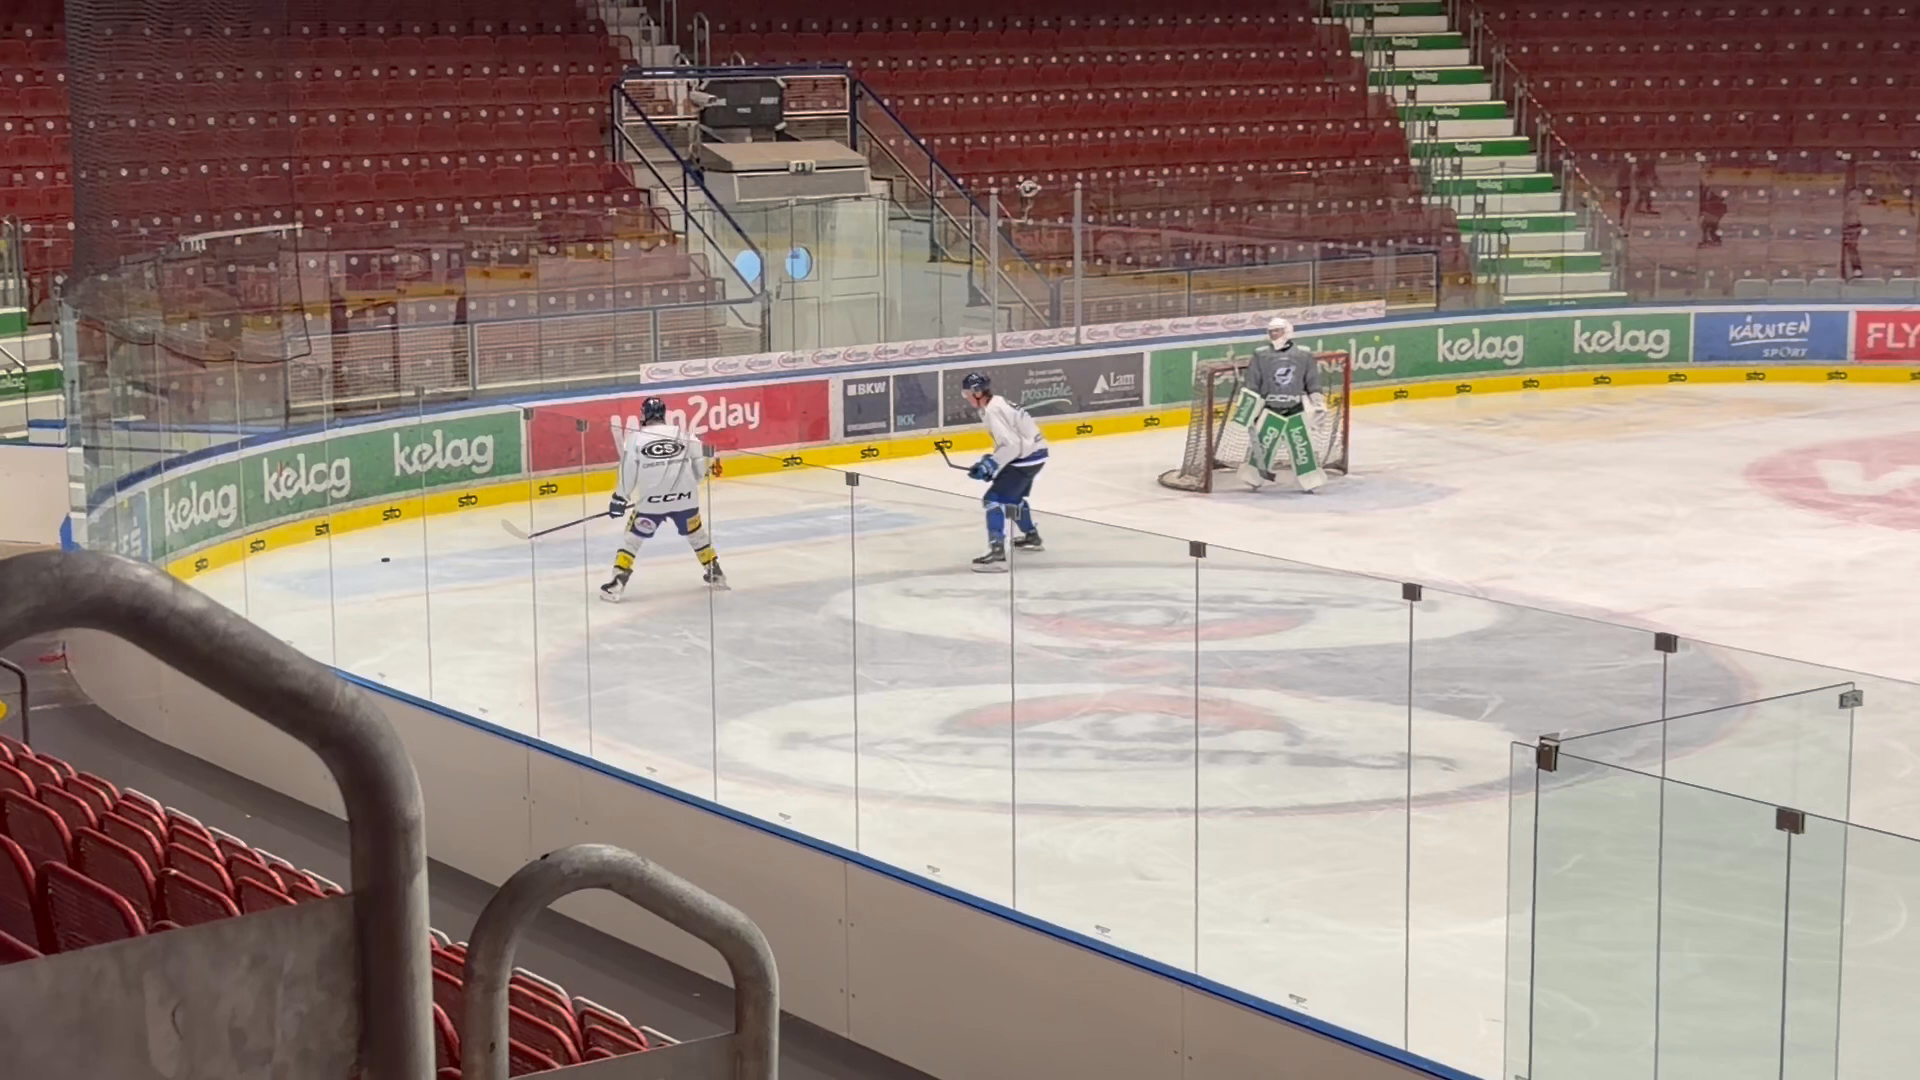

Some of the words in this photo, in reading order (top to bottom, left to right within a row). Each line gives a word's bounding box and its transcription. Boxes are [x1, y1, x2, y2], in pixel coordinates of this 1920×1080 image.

[1437, 328, 1524, 366] kelag
[1574, 320, 1670, 360] kelag
[1762, 348, 1809, 359] SPORT
[858, 381, 886, 396] BKW
[1109, 372, 1136, 387] Lam
[394, 429, 494, 476] kelag
[652, 443, 675, 455] CS
[1290, 426, 1309, 467] kelag
[263, 453, 350, 503] kelag
[163, 481, 237, 535] kelag
[647, 491, 692, 504] CCM
